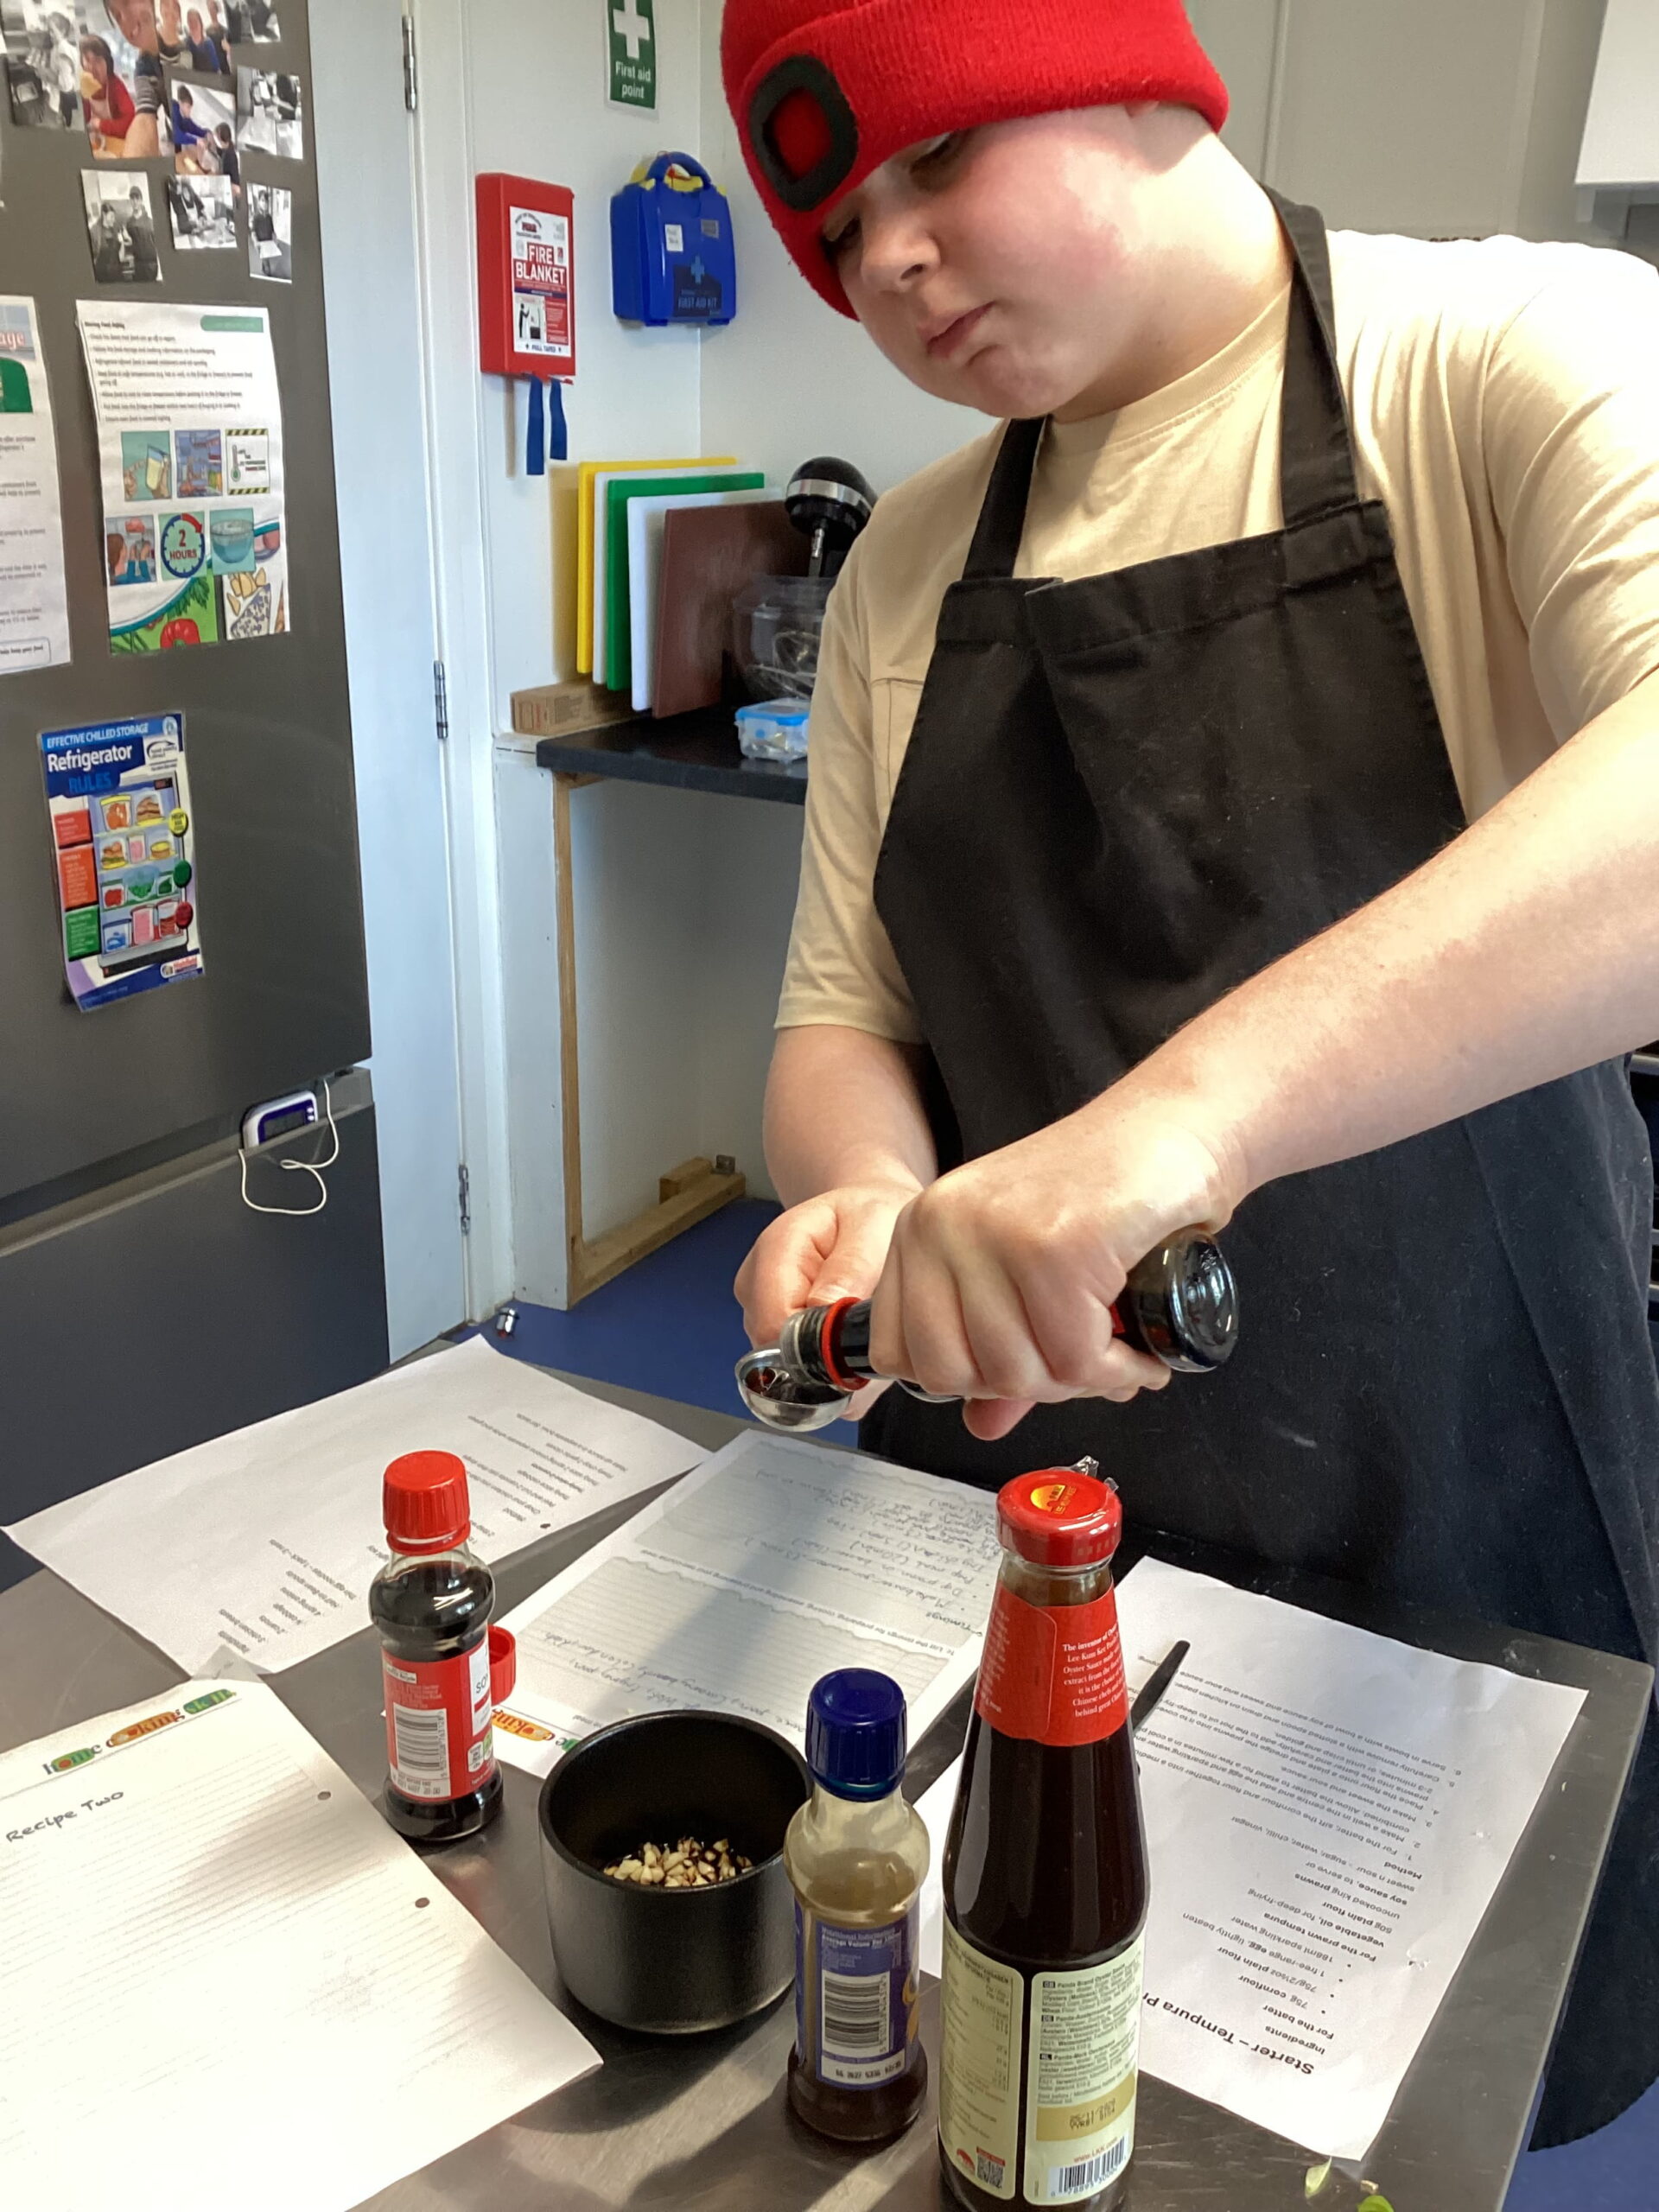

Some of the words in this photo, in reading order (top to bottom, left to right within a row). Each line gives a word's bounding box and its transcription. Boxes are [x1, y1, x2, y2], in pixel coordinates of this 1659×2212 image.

[616, 60, 636, 79] First
[637, 65, 651, 83] aid
[622, 81, 644, 99] point
[529, 245, 554, 264] FIRE
[515, 260, 565, 285] BLANKET
[0, 331, 26, 350] age
[178, 529, 187, 547] 2
[169, 549, 197, 560] HOURS
[47, 732, 86, 749] EFFECTIVE
[86, 728, 116, 743] CHILLED
[116, 722, 149, 737] STORAGE
[47, 744, 133, 773] Refrigerator
[69, 772, 111, 794] RULES
[1062, 1643, 1077, 1652] The
[1067, 1655, 1080, 1663] Lee
[1081, 1652, 1096, 1661] Kum
[1096, 1647, 1106, 1656] Kee
[1063, 1665, 1086, 1675] Oyster
[1086, 1659, 1103, 1670] Sauce
[1064, 1676, 1087, 1686] extract
[1088, 1672, 1103, 1682] from
[1091, 1682, 1101, 1691] the
[1072, 1695, 1098, 1707] Chinese
[1075, 1706, 1098, 1718] behind
[1098, 1700, 1111, 1713] great
[43, 1744, 103, 1776] home
[105, 1709, 185, 1748] cooking
[6, 1810, 77, 1843] Recipe
[81, 1791, 124, 1812] Two
[1316, 1865, 1342, 1879] serve
[1383, 1861, 1422, 1880] Method
[1294, 1873, 1331, 1891] prawns
[1343, 1876, 1353, 1885] to
[1247, 1887, 1301, 1914] deep-frying
[1330, 1886, 1351, 1901] king
[1389, 1894, 1407, 1905] soy
[1301, 1910, 1315, 1921] for
[1321, 1901, 1346, 1916] flour
[1351, 1896, 1400, 1920] uncooked
[1182, 1912, 1215, 1931] beaten
[1230, 1916, 1258, 1932] water
[1263, 1912, 1305, 1934] tempura
[1346, 1911, 1374, 1926] plain
[1215, 1926, 1245, 1945] lightly
[1258, 1926, 1302, 1950] sparkling
[1307, 1930, 1340, 1947] prawn
[1334, 1924, 1384, 1948] vegetable
[1216, 1946, 1241, 1961] flour
[1302, 1946, 1333, 1963] 188ml
[1340, 1944, 1357, 1955] the
[1358, 1951, 1376, 1962] For
[1242, 1957, 1270, 1972] plain
[1268, 1950, 1318, 1974] free-range
[1237, 1974, 1286, 1998] cornflour
[1142, 1992, 1160, 2007] Pr
[1289, 1994, 1308, 2009] 75g
[1162, 2001, 1234, 2044] Tempura
[1262, 2004, 1295, 2023] batter
[1296, 2019, 1314, 2031] the
[1315, 2027, 1334, 2040] For
[1264, 2025, 1325, 2055] Ingredients
[1250, 2044, 1314, 2074] Starter
